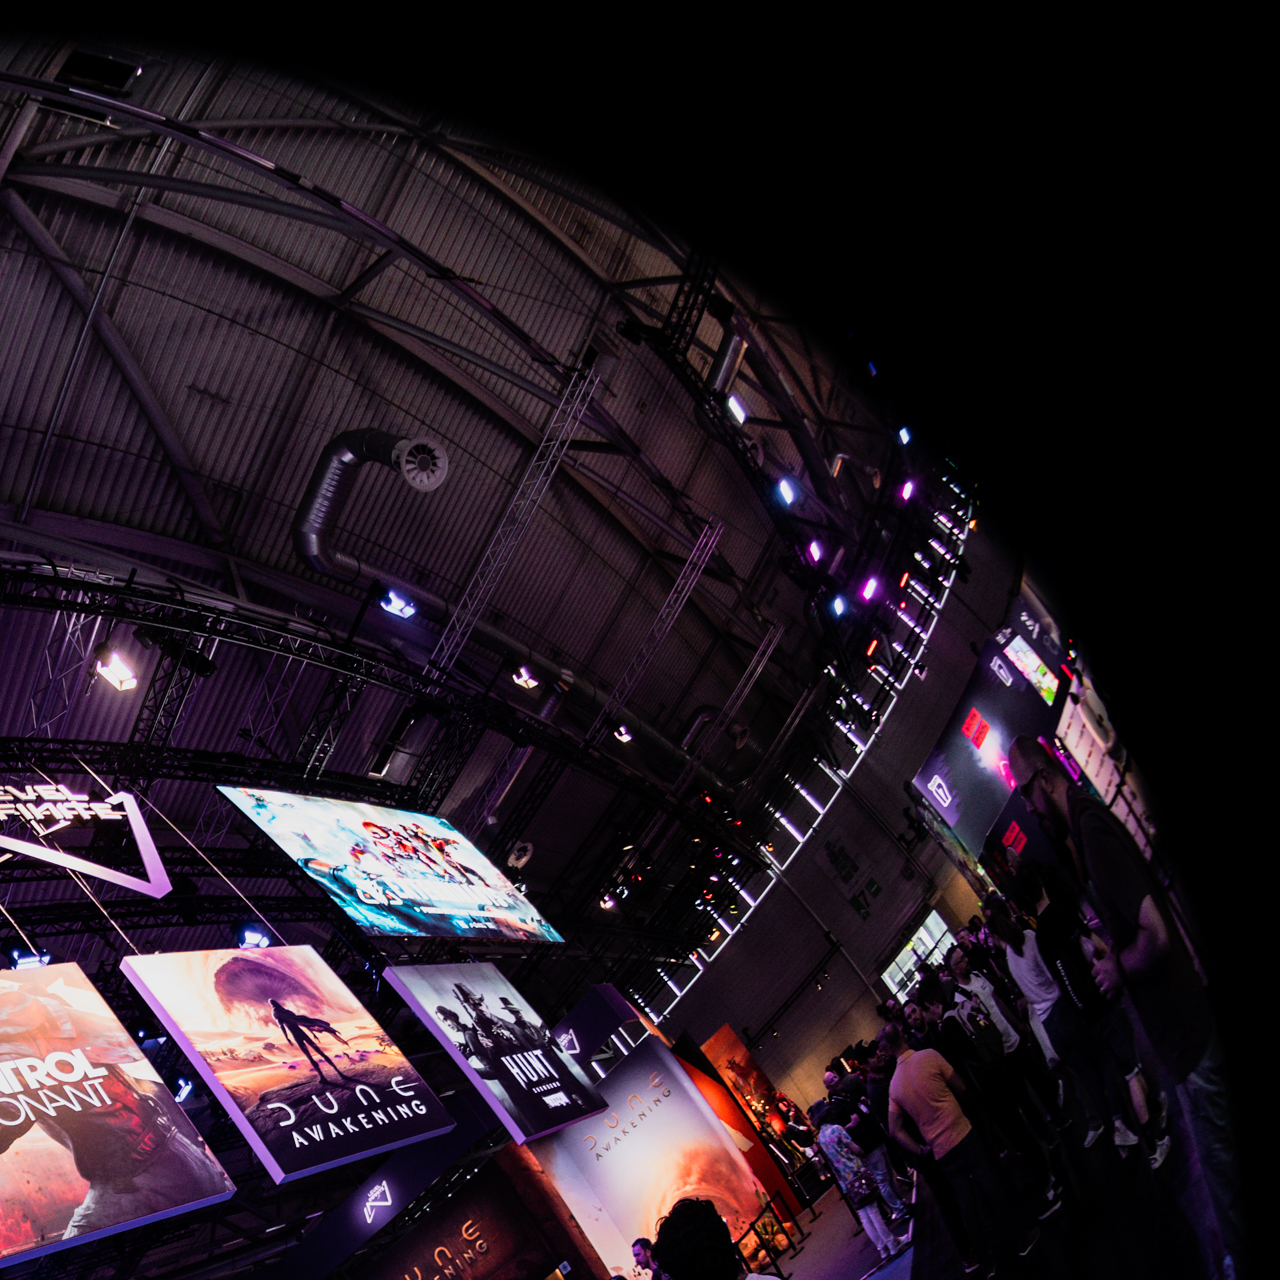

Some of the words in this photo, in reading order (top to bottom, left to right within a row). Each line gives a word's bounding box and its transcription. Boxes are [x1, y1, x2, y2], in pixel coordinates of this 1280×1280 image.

[500, 1049, 560, 1091] HUNT
[291, 1099, 428, 1149] AWAKENING
[595, 1087, 672, 1162] AWAKENING
